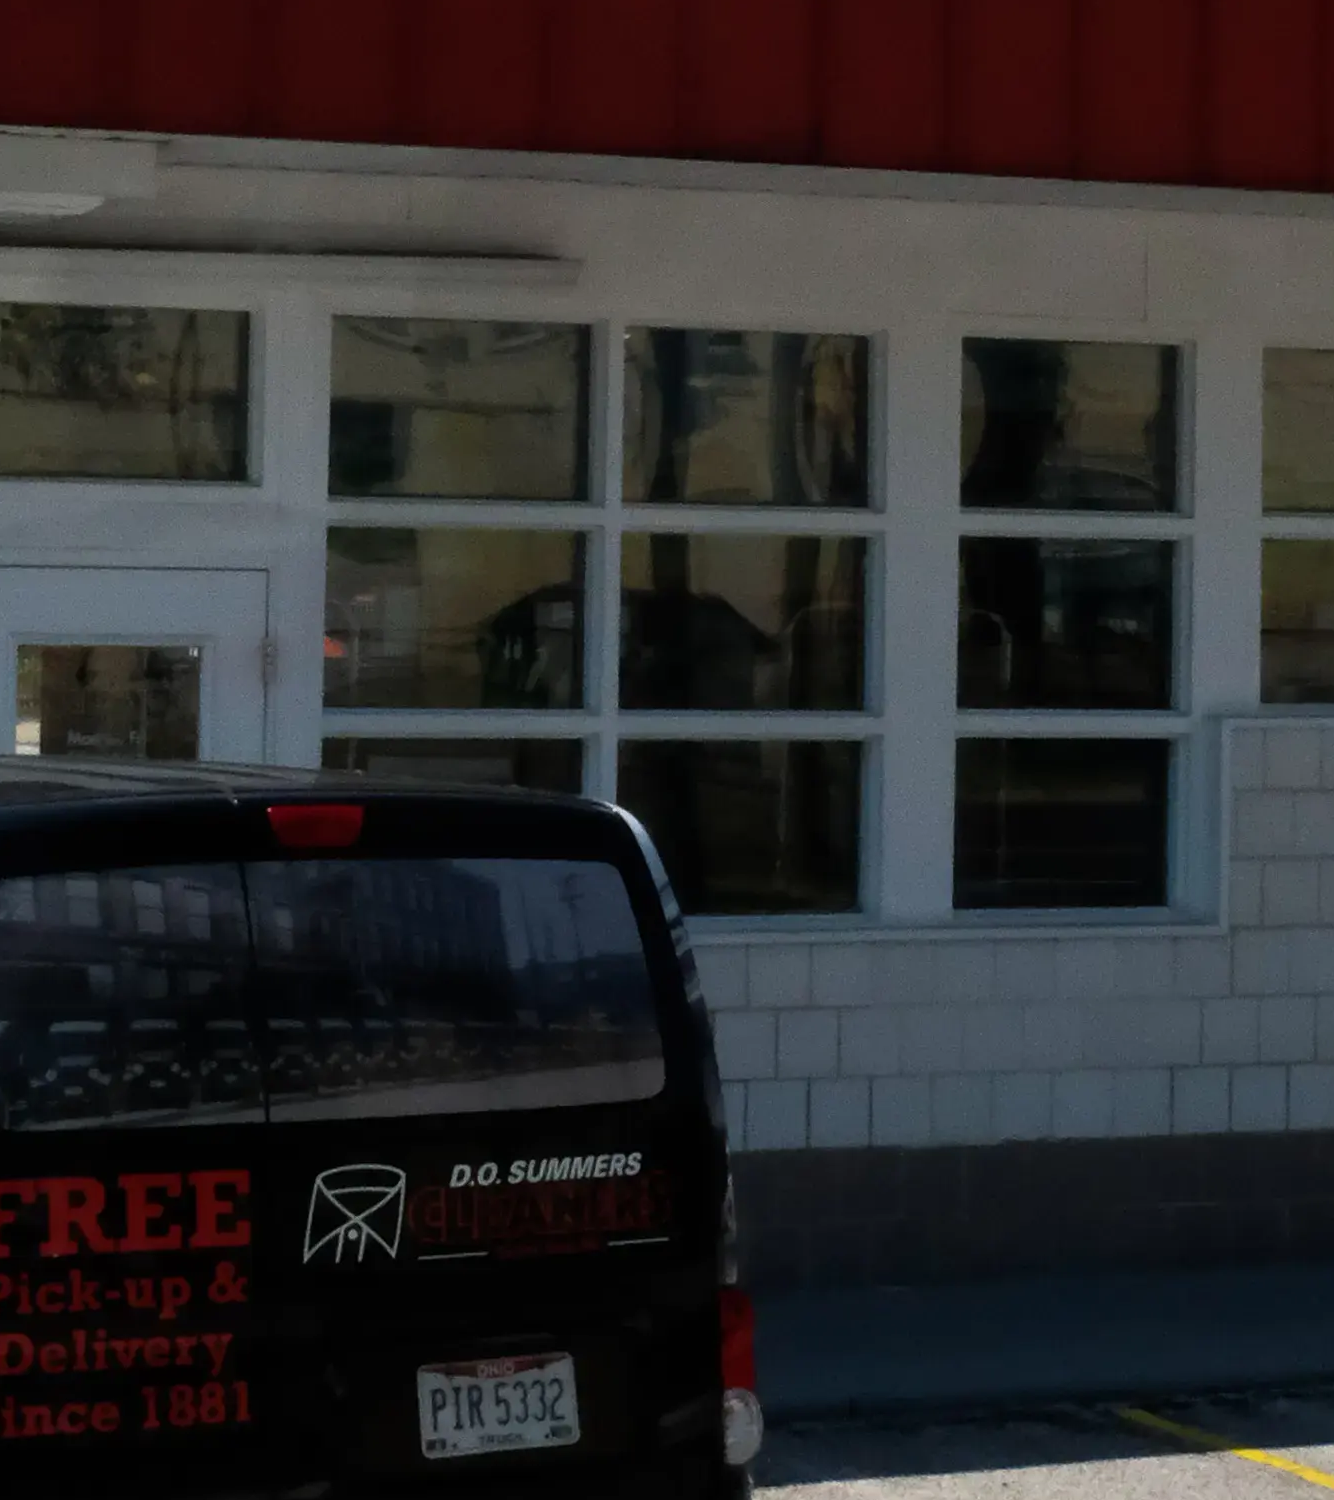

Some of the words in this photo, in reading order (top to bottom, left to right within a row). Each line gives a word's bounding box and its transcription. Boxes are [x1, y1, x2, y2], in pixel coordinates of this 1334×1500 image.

[449, 1163, 502, 1189] D.O.
[507, 1151, 643, 1185] SUMMERS
[207, 1260, 249, 1304] &
[476, 1362, 515, 1378] OHIO
[141, 1379, 251, 1430] 1881
[430, 1384, 485, 1432] PIR
[493, 1378, 565, 1426] 5332
